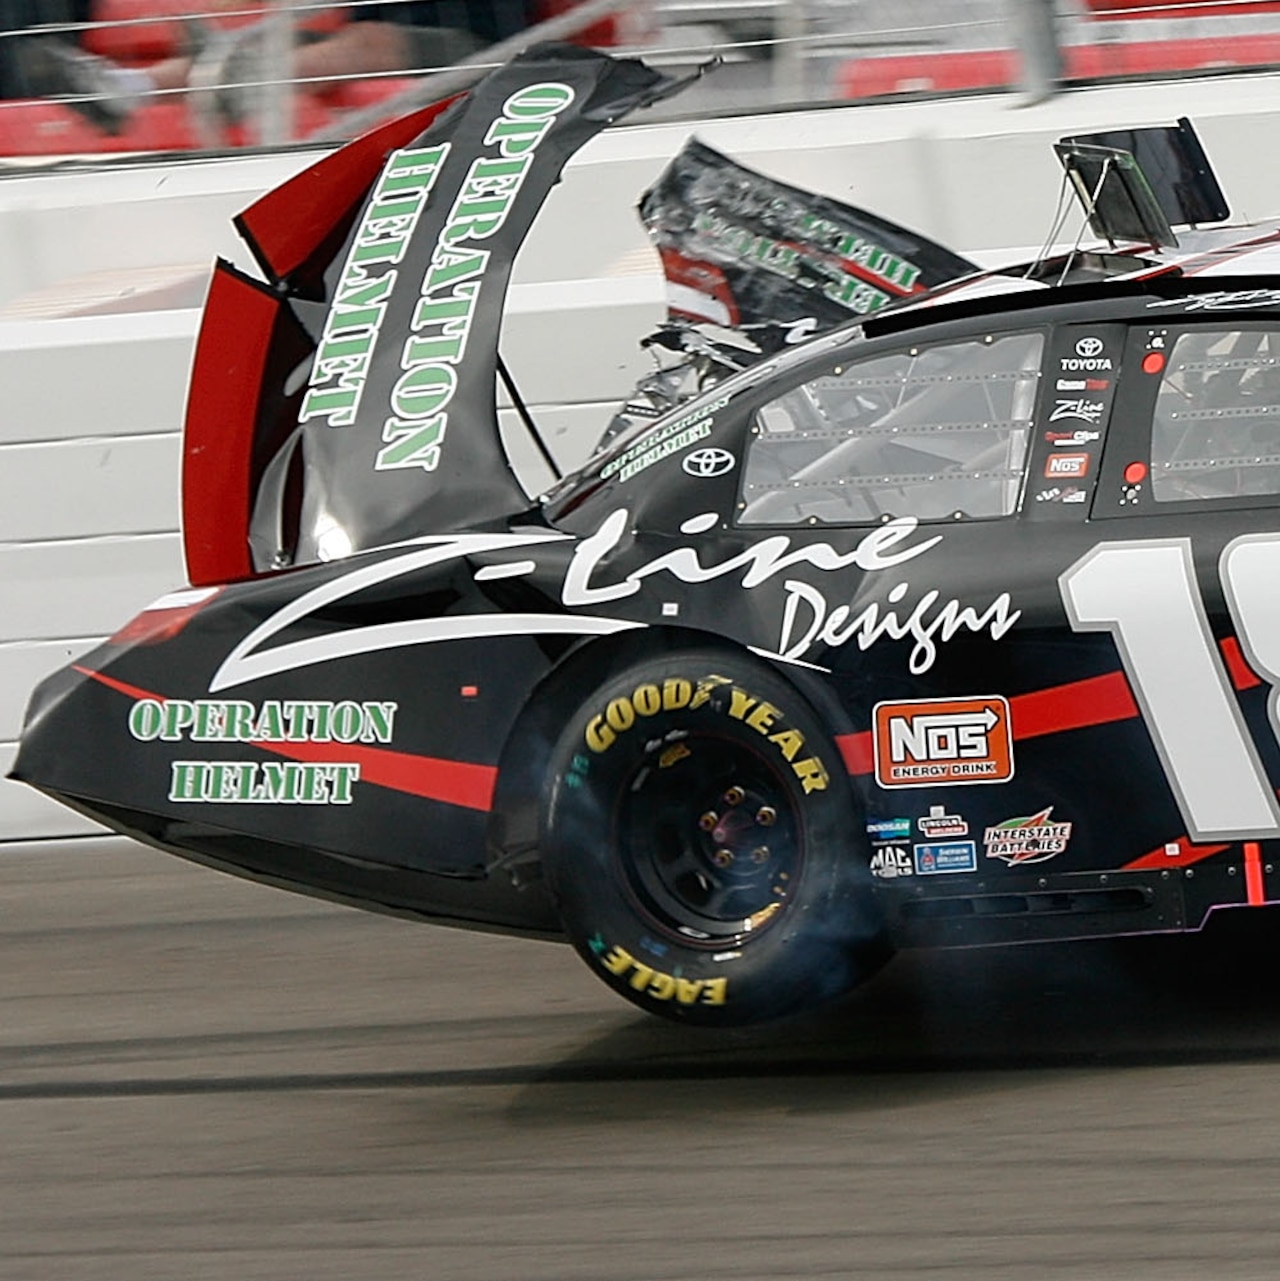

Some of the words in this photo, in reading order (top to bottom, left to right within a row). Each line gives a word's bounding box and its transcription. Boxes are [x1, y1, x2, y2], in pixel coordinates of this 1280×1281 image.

[298, 142, 451, 426] HELMET
[375, 82, 575, 471] OPERATION
[1061, 359, 1112, 371] TOYOTA
[1050, 457, 1086, 472] NOS
[129, 700, 398, 742] OPERATION
[889, 708, 998, 763] NOS
[169, 761, 360, 804] HELMET
[892, 765, 948, 778] ENERGY
[952, 762, 997, 774] DRINK
[986, 825, 1069, 841] INTERSTATE
[871, 867, 913, 877] TLS
[600, 944, 728, 1006] EAGLE
